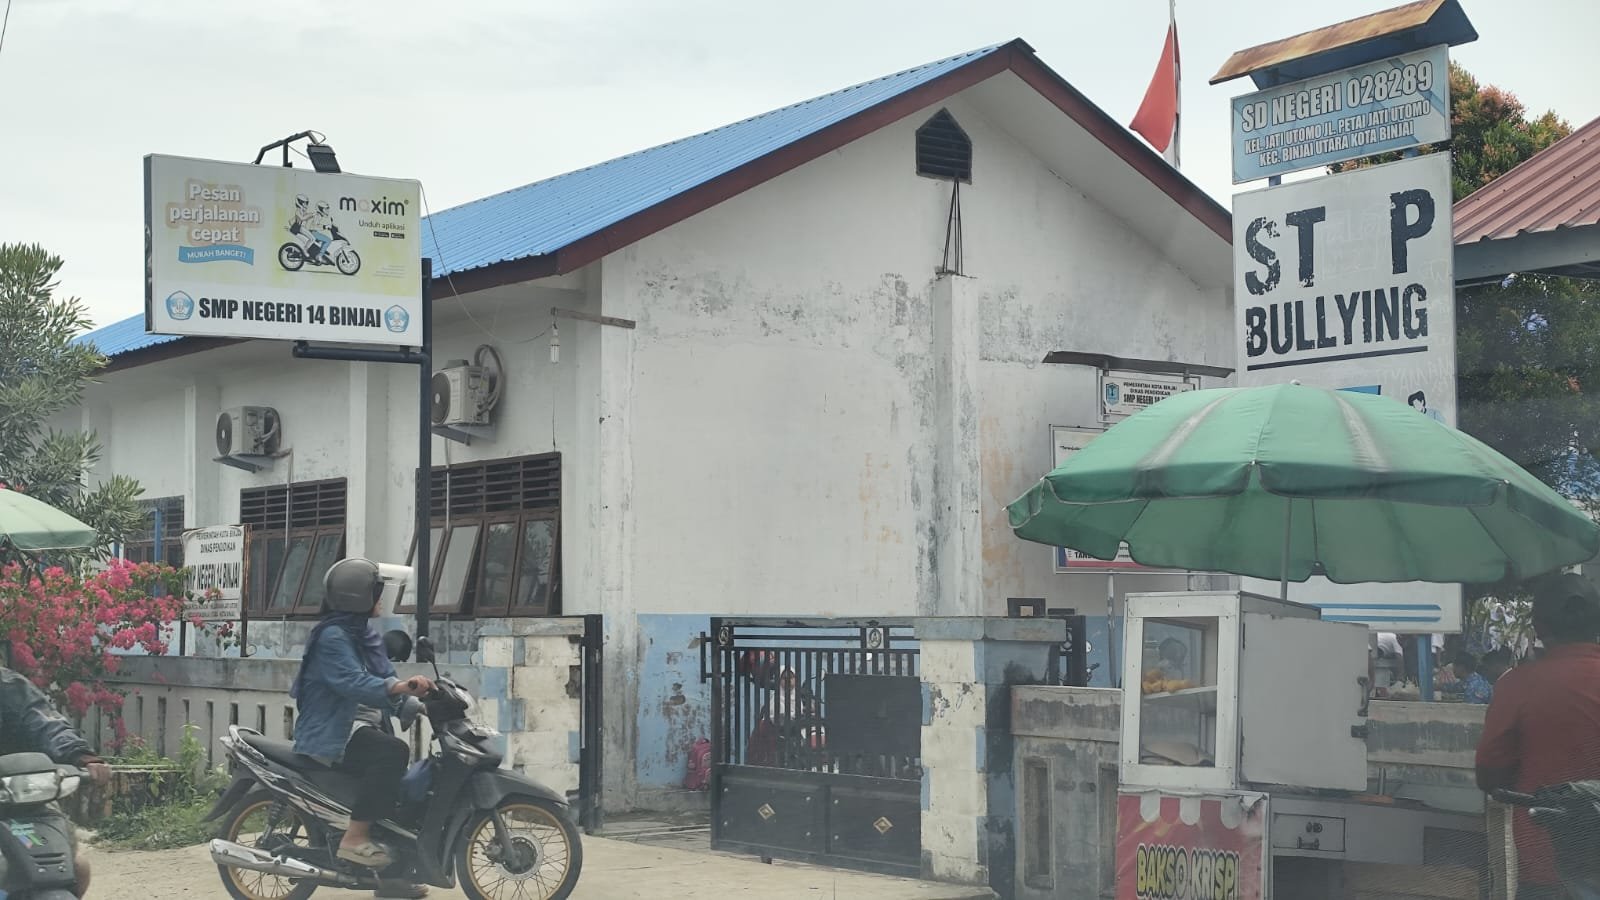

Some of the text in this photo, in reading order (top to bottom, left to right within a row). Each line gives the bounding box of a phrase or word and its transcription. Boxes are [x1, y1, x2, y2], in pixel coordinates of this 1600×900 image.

[1242, 60, 1433, 132] SD NEGERI 028289
[1244, 99, 1431, 154] KEL. JATI UTOMO JL. PETAI JATI UTOMO
[1259, 120, 1415, 167] KEC. BINJAI UTARA KOTA BINJAI
[189, 183, 241, 202] Pesan
[170, 204, 260, 224] perjalanan
[339, 196, 405, 216] maxim
[191, 226, 241, 245] cepat
[358, 219, 381, 228] Unduh
[187, 250, 214, 260] MURAH
[199, 298, 381, 328] SMP NEGERI 14 BINJAI
[1245, 283, 1429, 358] BULLYING
[1137, 844, 1240, 900] BAKSO KRISPI
